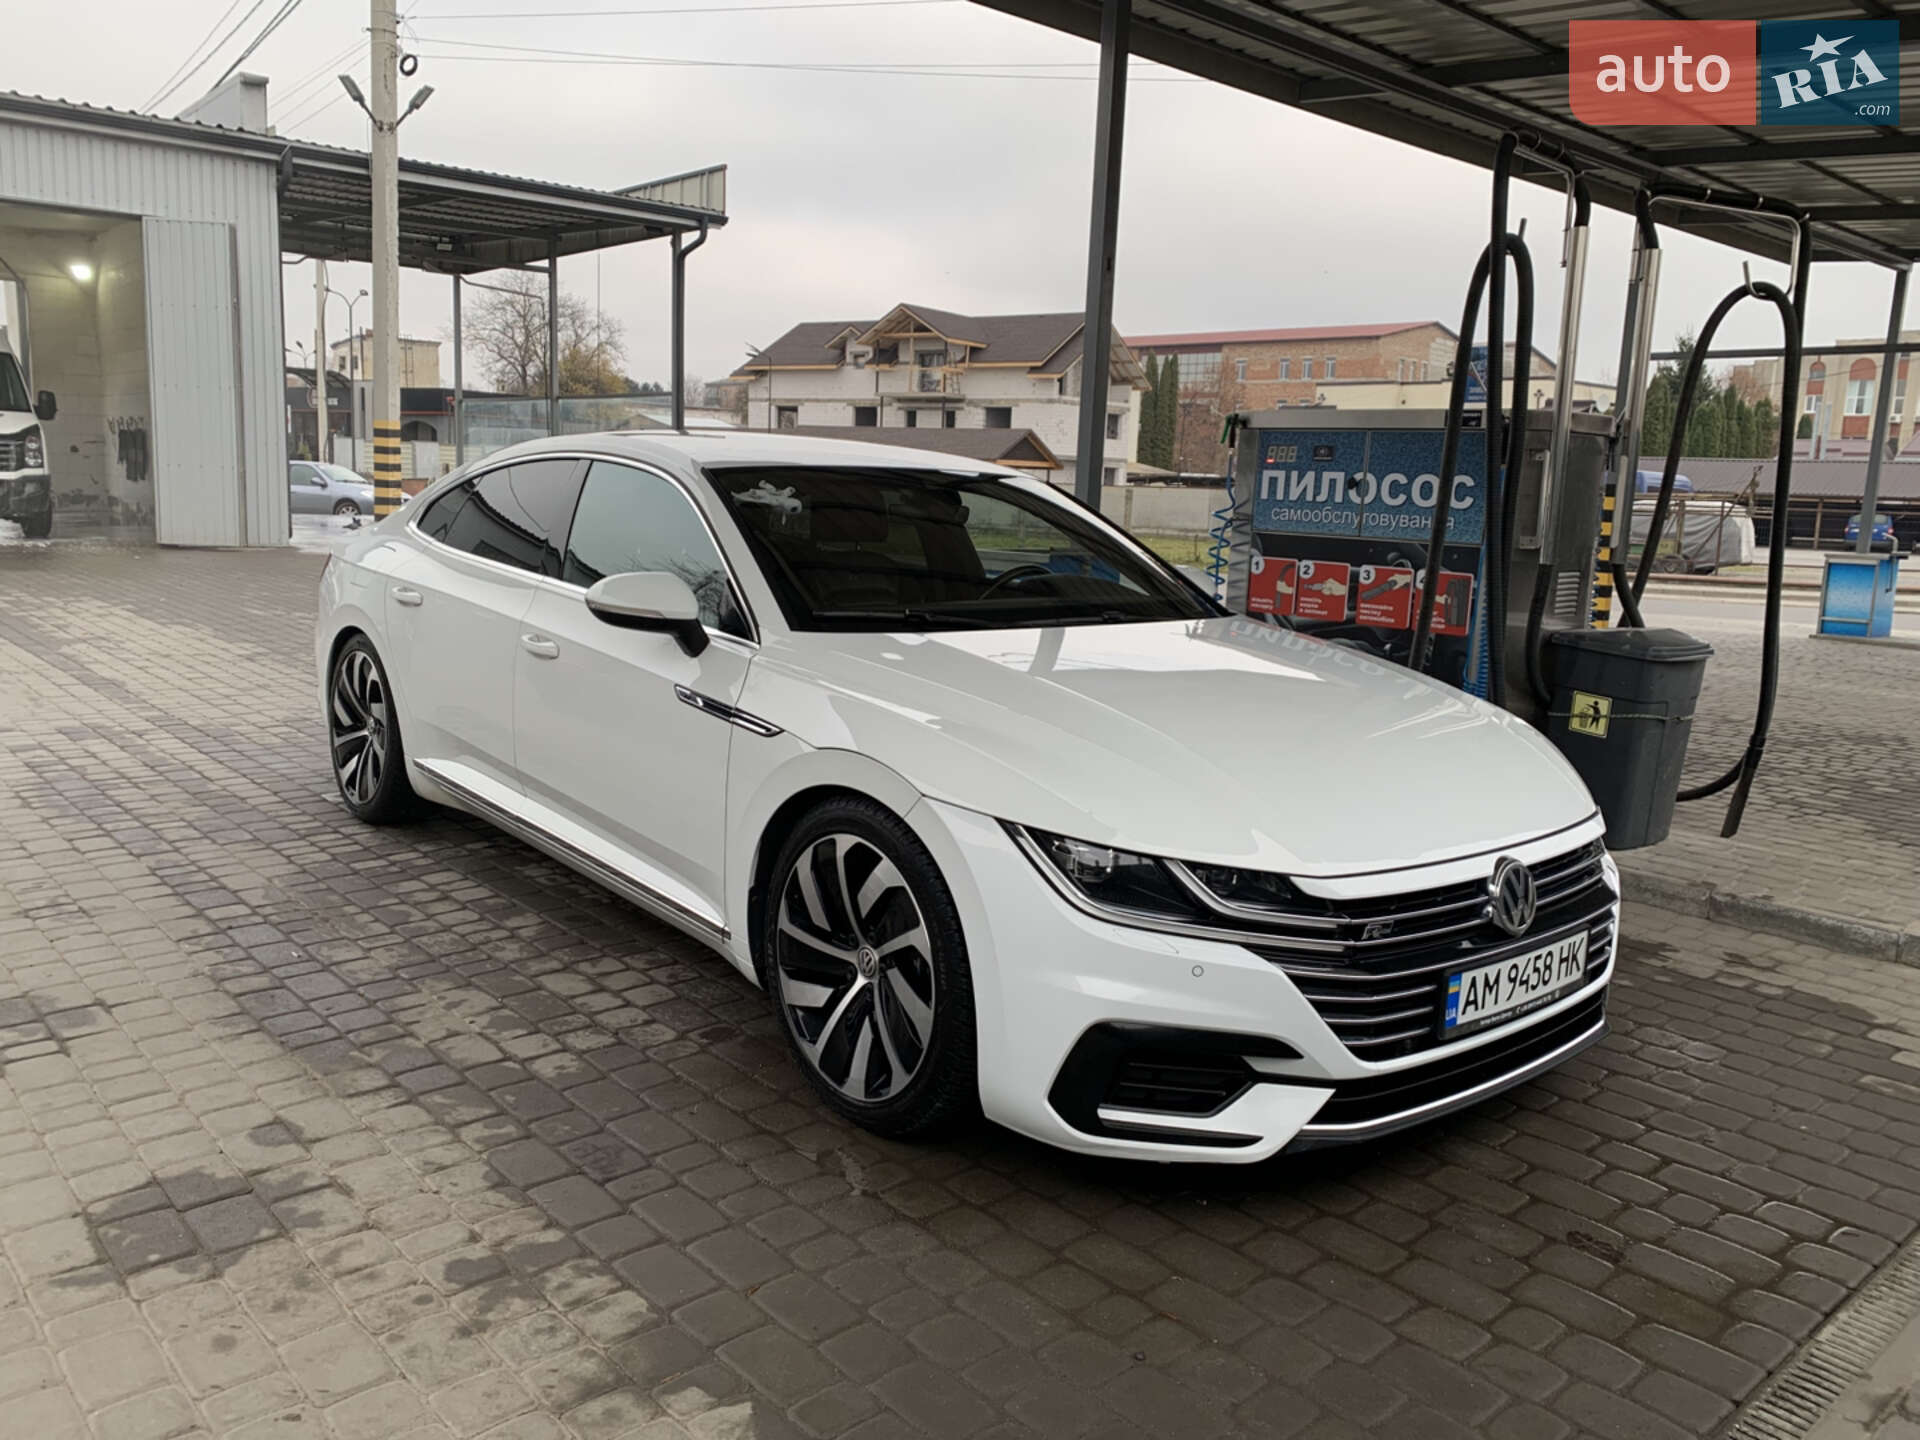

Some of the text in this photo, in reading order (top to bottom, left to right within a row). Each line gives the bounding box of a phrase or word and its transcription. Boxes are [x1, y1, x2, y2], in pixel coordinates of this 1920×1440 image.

[1259, 469, 1476, 510] ПИЛОСОС
[1271, 505, 1455, 531] самообслуговуваня
[1302, 564, 1311, 576] 2
[1363, 569, 1371, 581] 3
[1462, 968, 1502, 1015] AM
[1506, 950, 1554, 1002] 9458
[1557, 937, 1585, 982] HK
